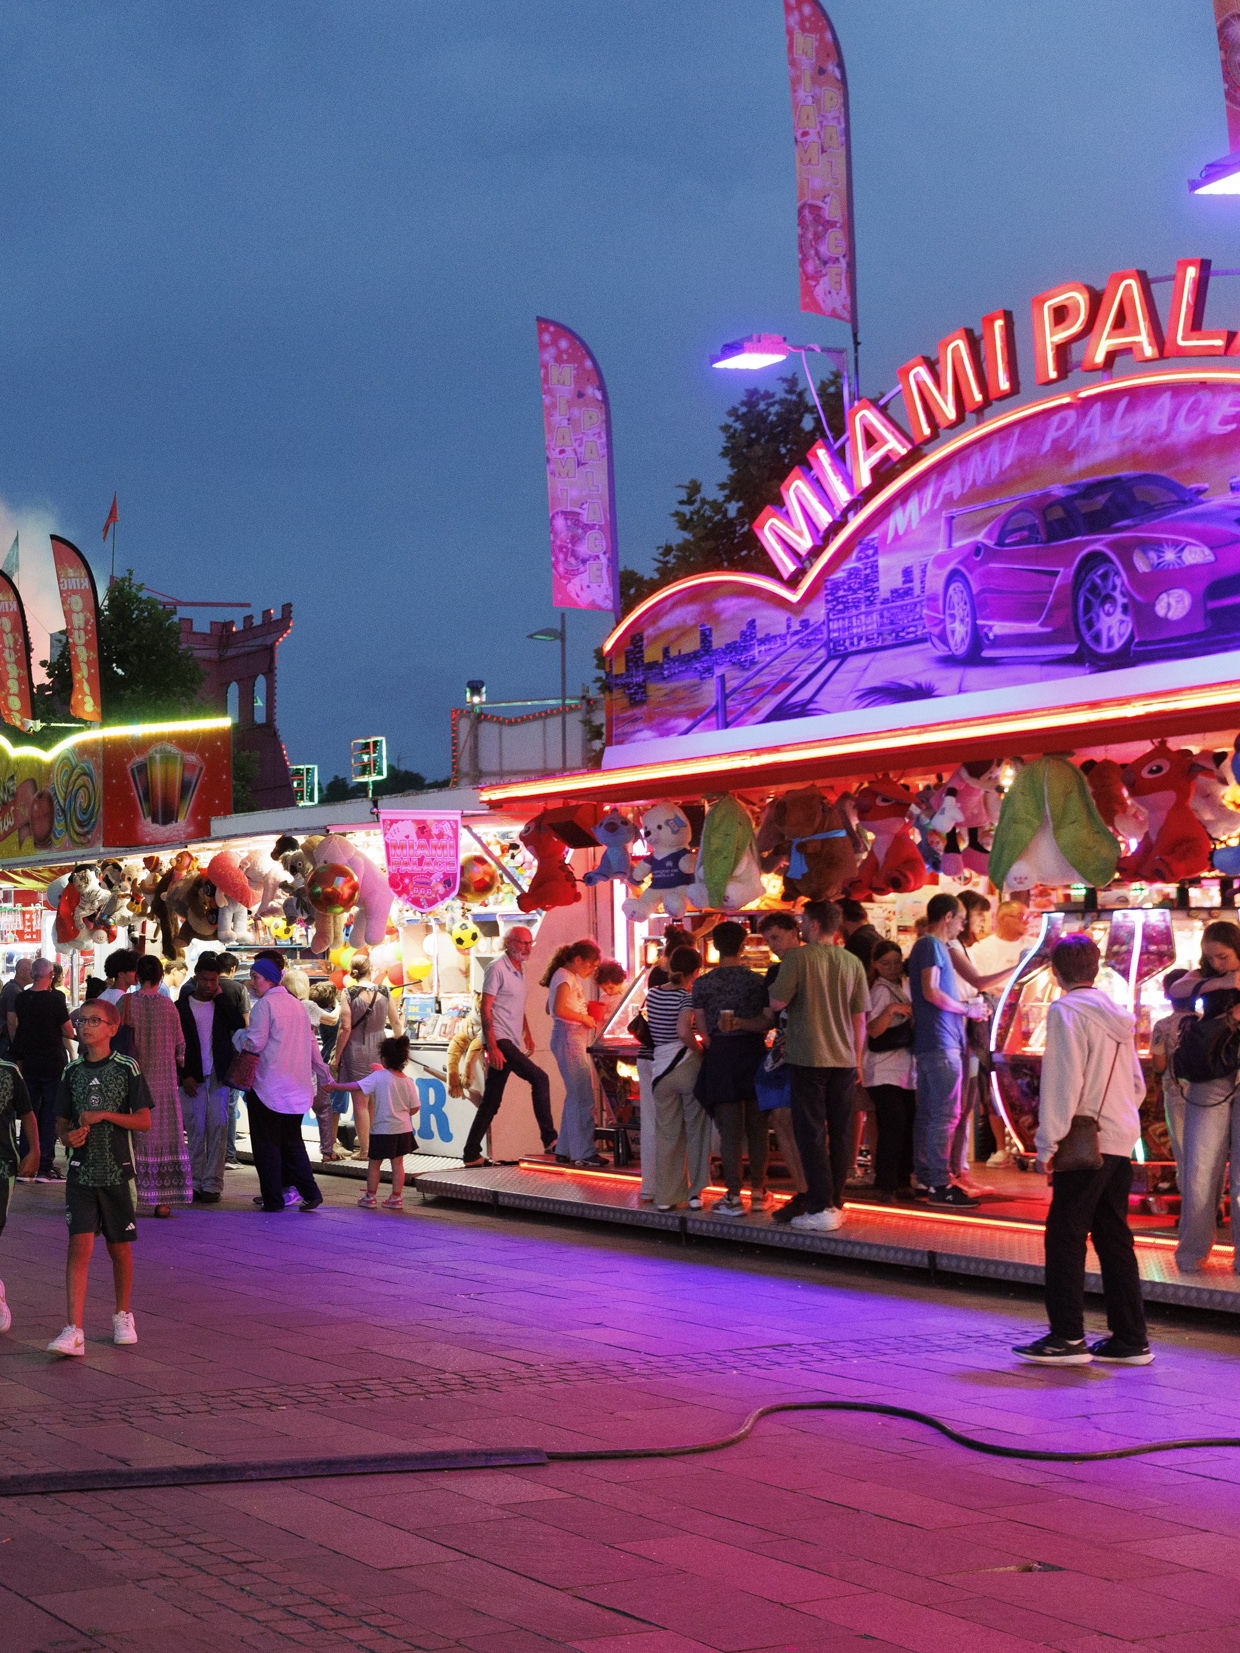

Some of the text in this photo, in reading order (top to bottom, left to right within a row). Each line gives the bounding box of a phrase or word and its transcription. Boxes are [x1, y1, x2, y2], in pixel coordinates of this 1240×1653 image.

[793, 30, 821, 200] MIAMI
[822, 86, 846, 291] PALACE
[548, 363, 578, 510] MIAMI
[580, 408, 606, 584] PALACE
[752, 257, 1240, 581] MIAMI PAL
[886, 390, 1240, 544] MIAMI PALACE
[390, 839, 456, 857] MIAMI
[390, 857, 457, 873] PALACE
